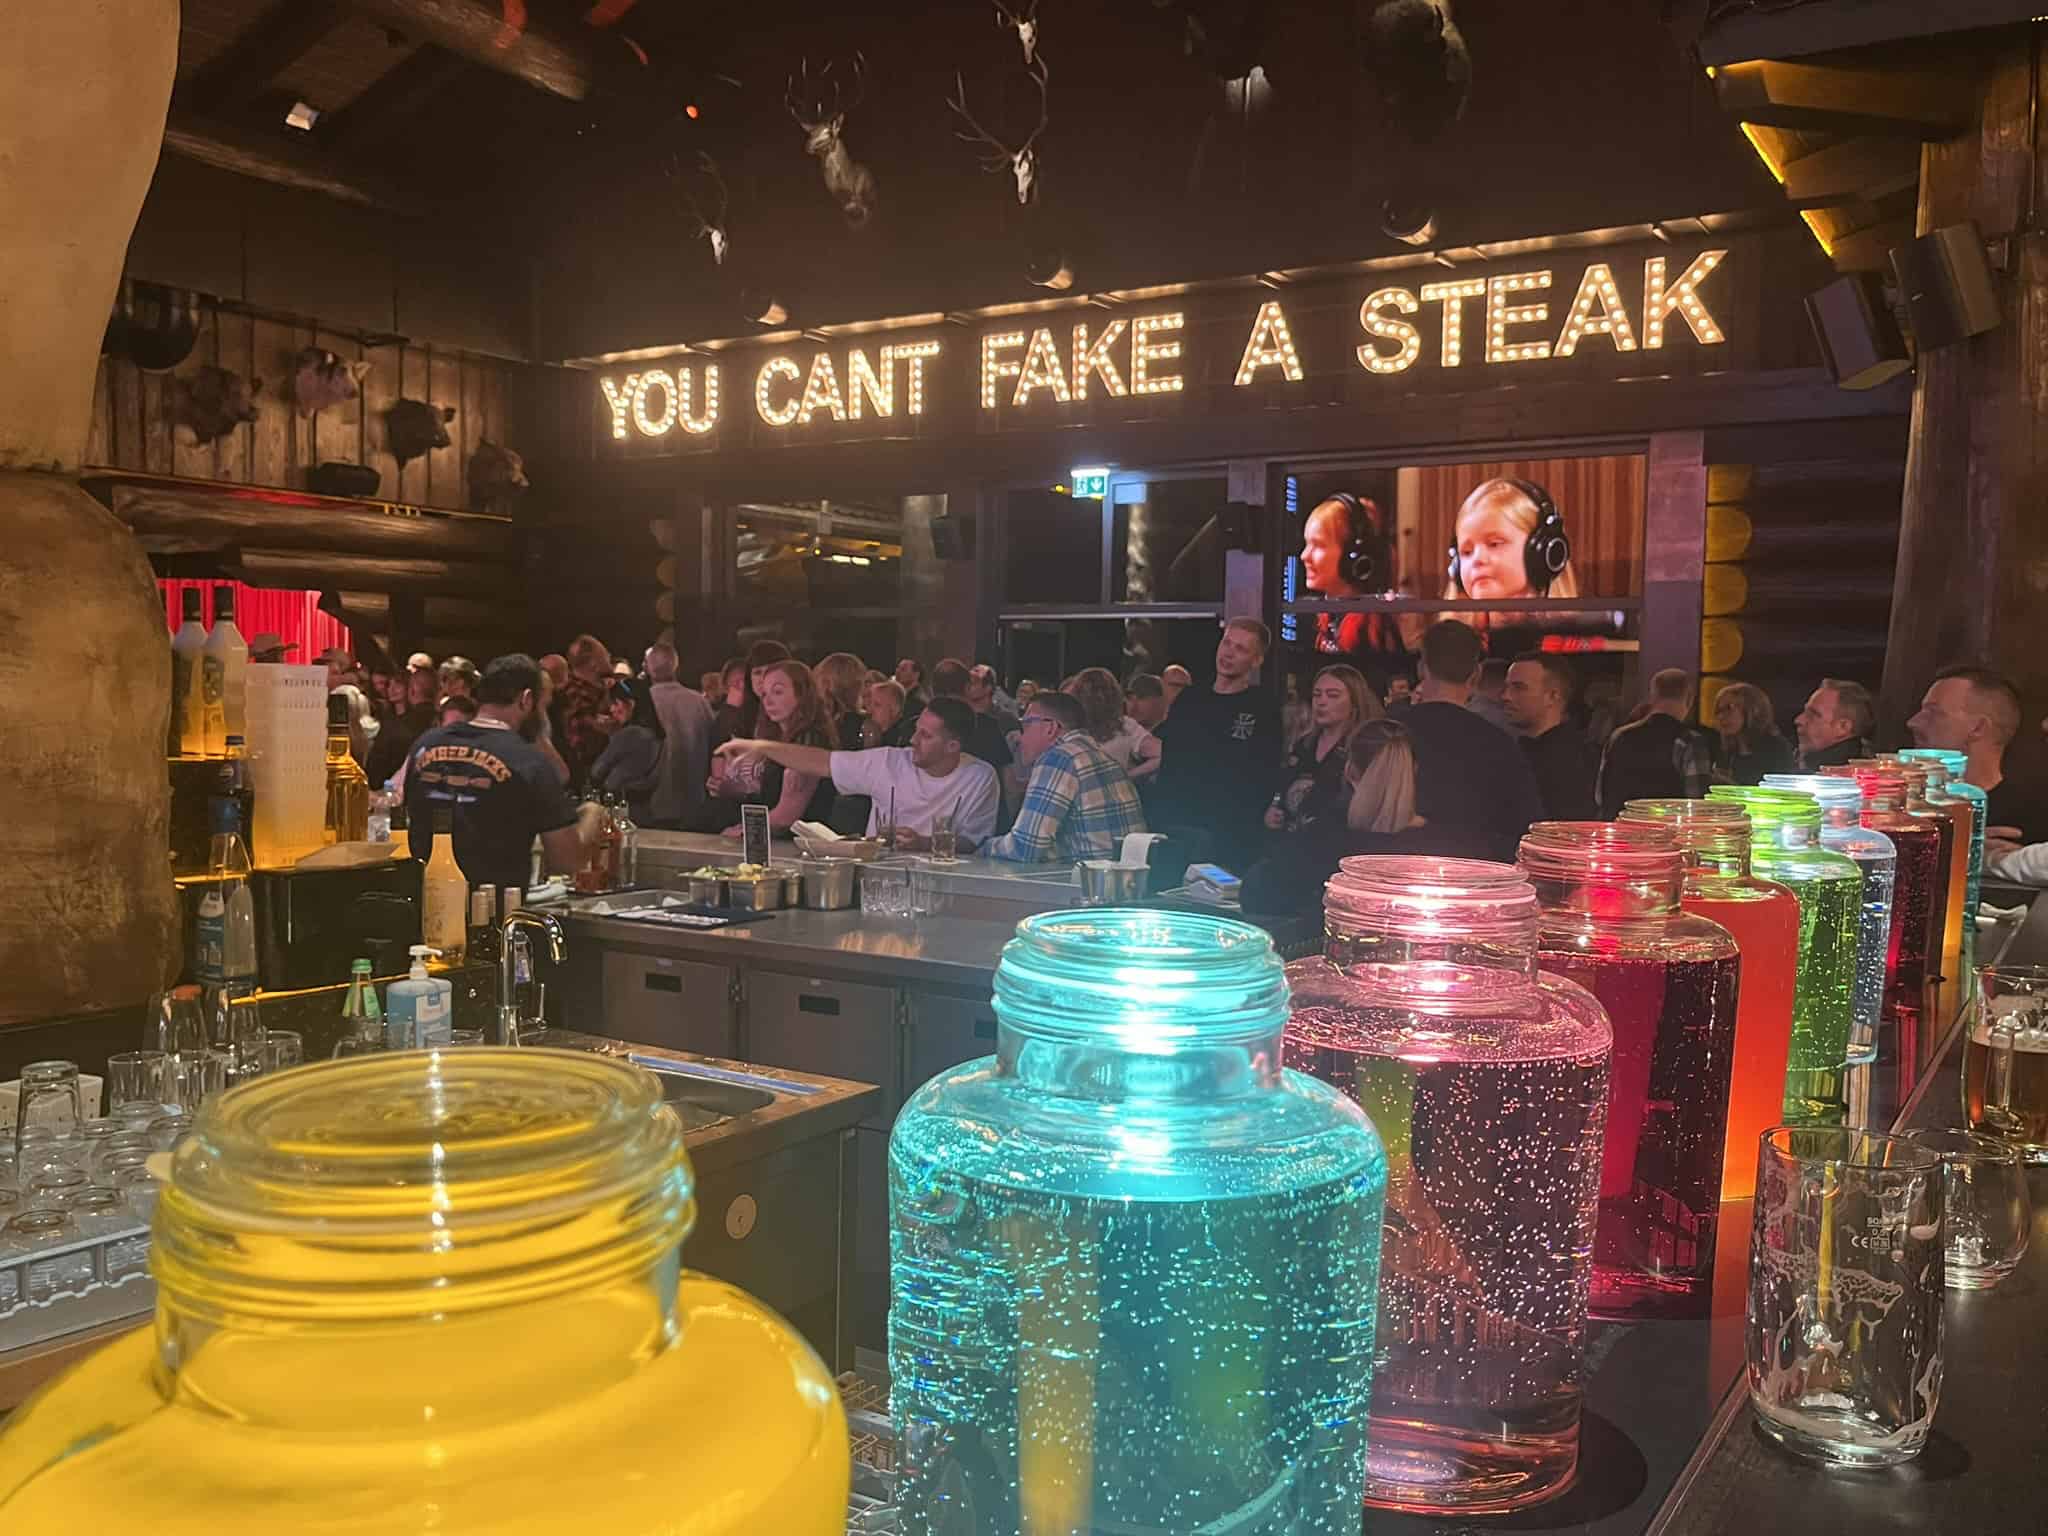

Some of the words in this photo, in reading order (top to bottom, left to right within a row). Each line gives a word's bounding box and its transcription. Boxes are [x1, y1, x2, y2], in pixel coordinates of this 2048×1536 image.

[600, 365, 720, 440] YOU
[755, 340, 940, 426] CANT
[981, 311, 1185, 409] FAKE
[1234, 301, 1304, 386] A
[1356, 249, 1729, 374] STEAK
